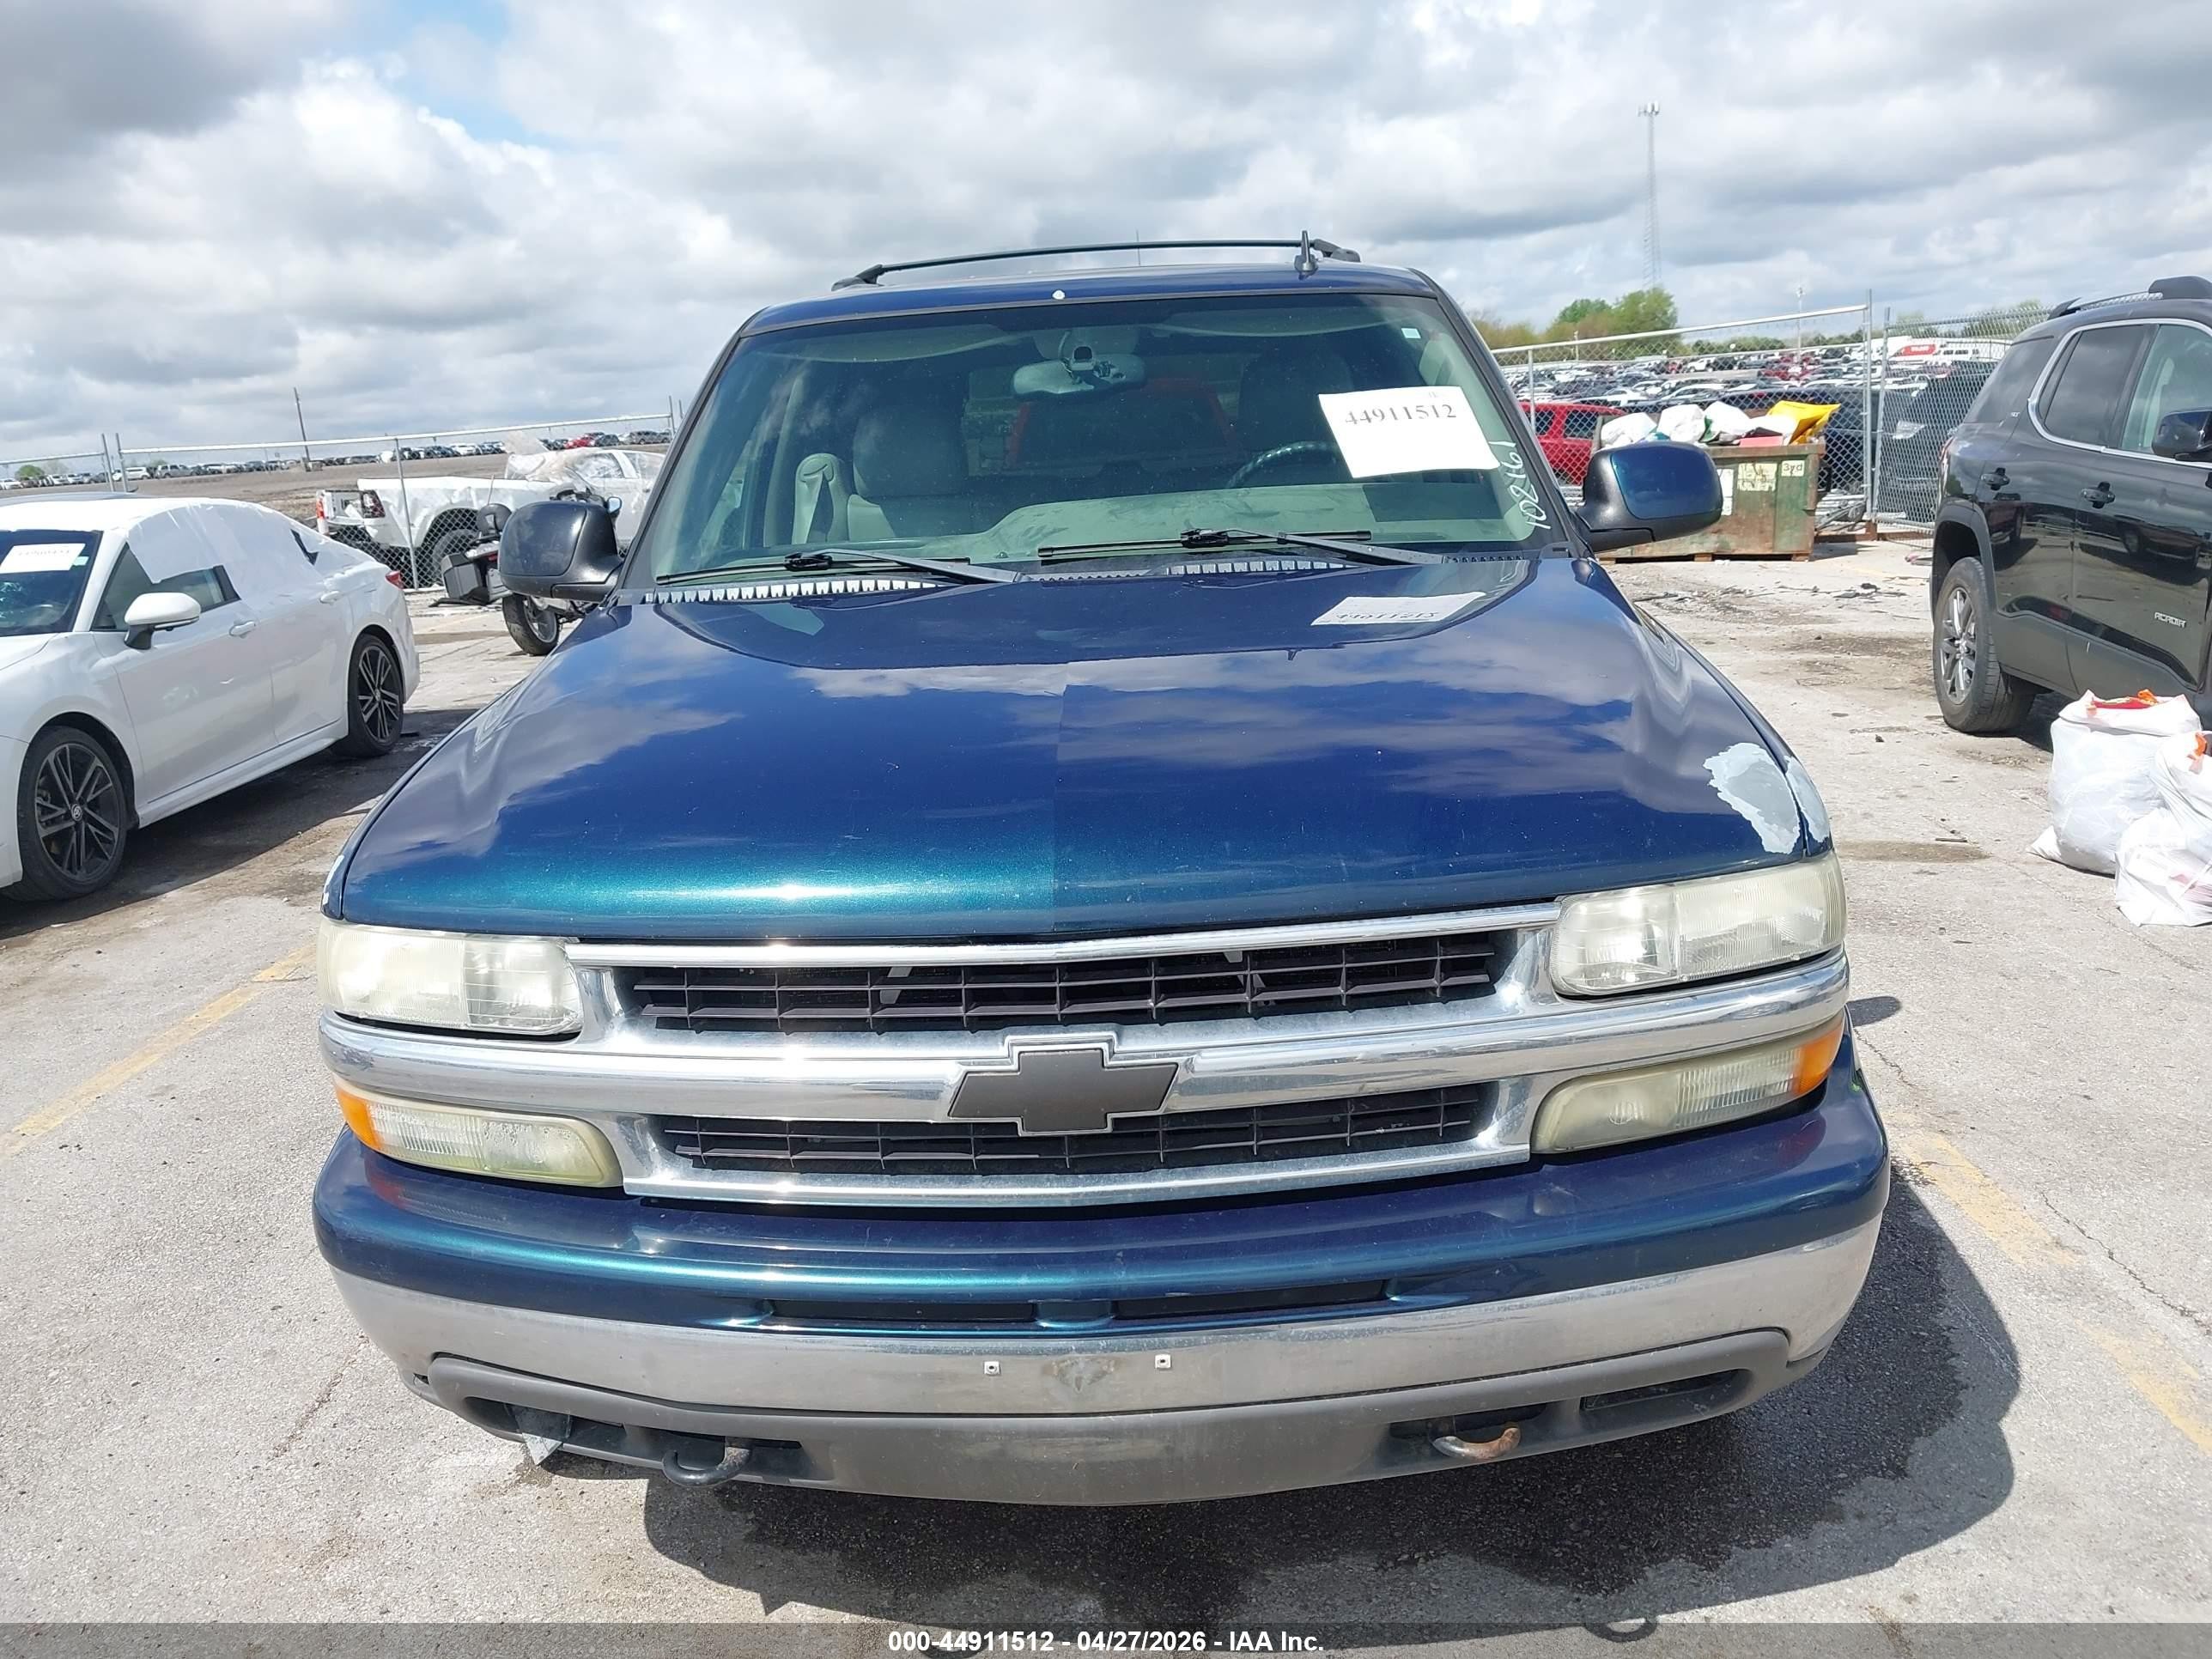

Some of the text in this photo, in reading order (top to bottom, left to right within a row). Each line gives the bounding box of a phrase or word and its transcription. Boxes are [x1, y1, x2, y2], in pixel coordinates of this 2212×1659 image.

[1345, 404, 1457, 425] 44911512
[1487, 441, 1552, 530] 102161
[2154, 611, 2187, 629] ACADIA
